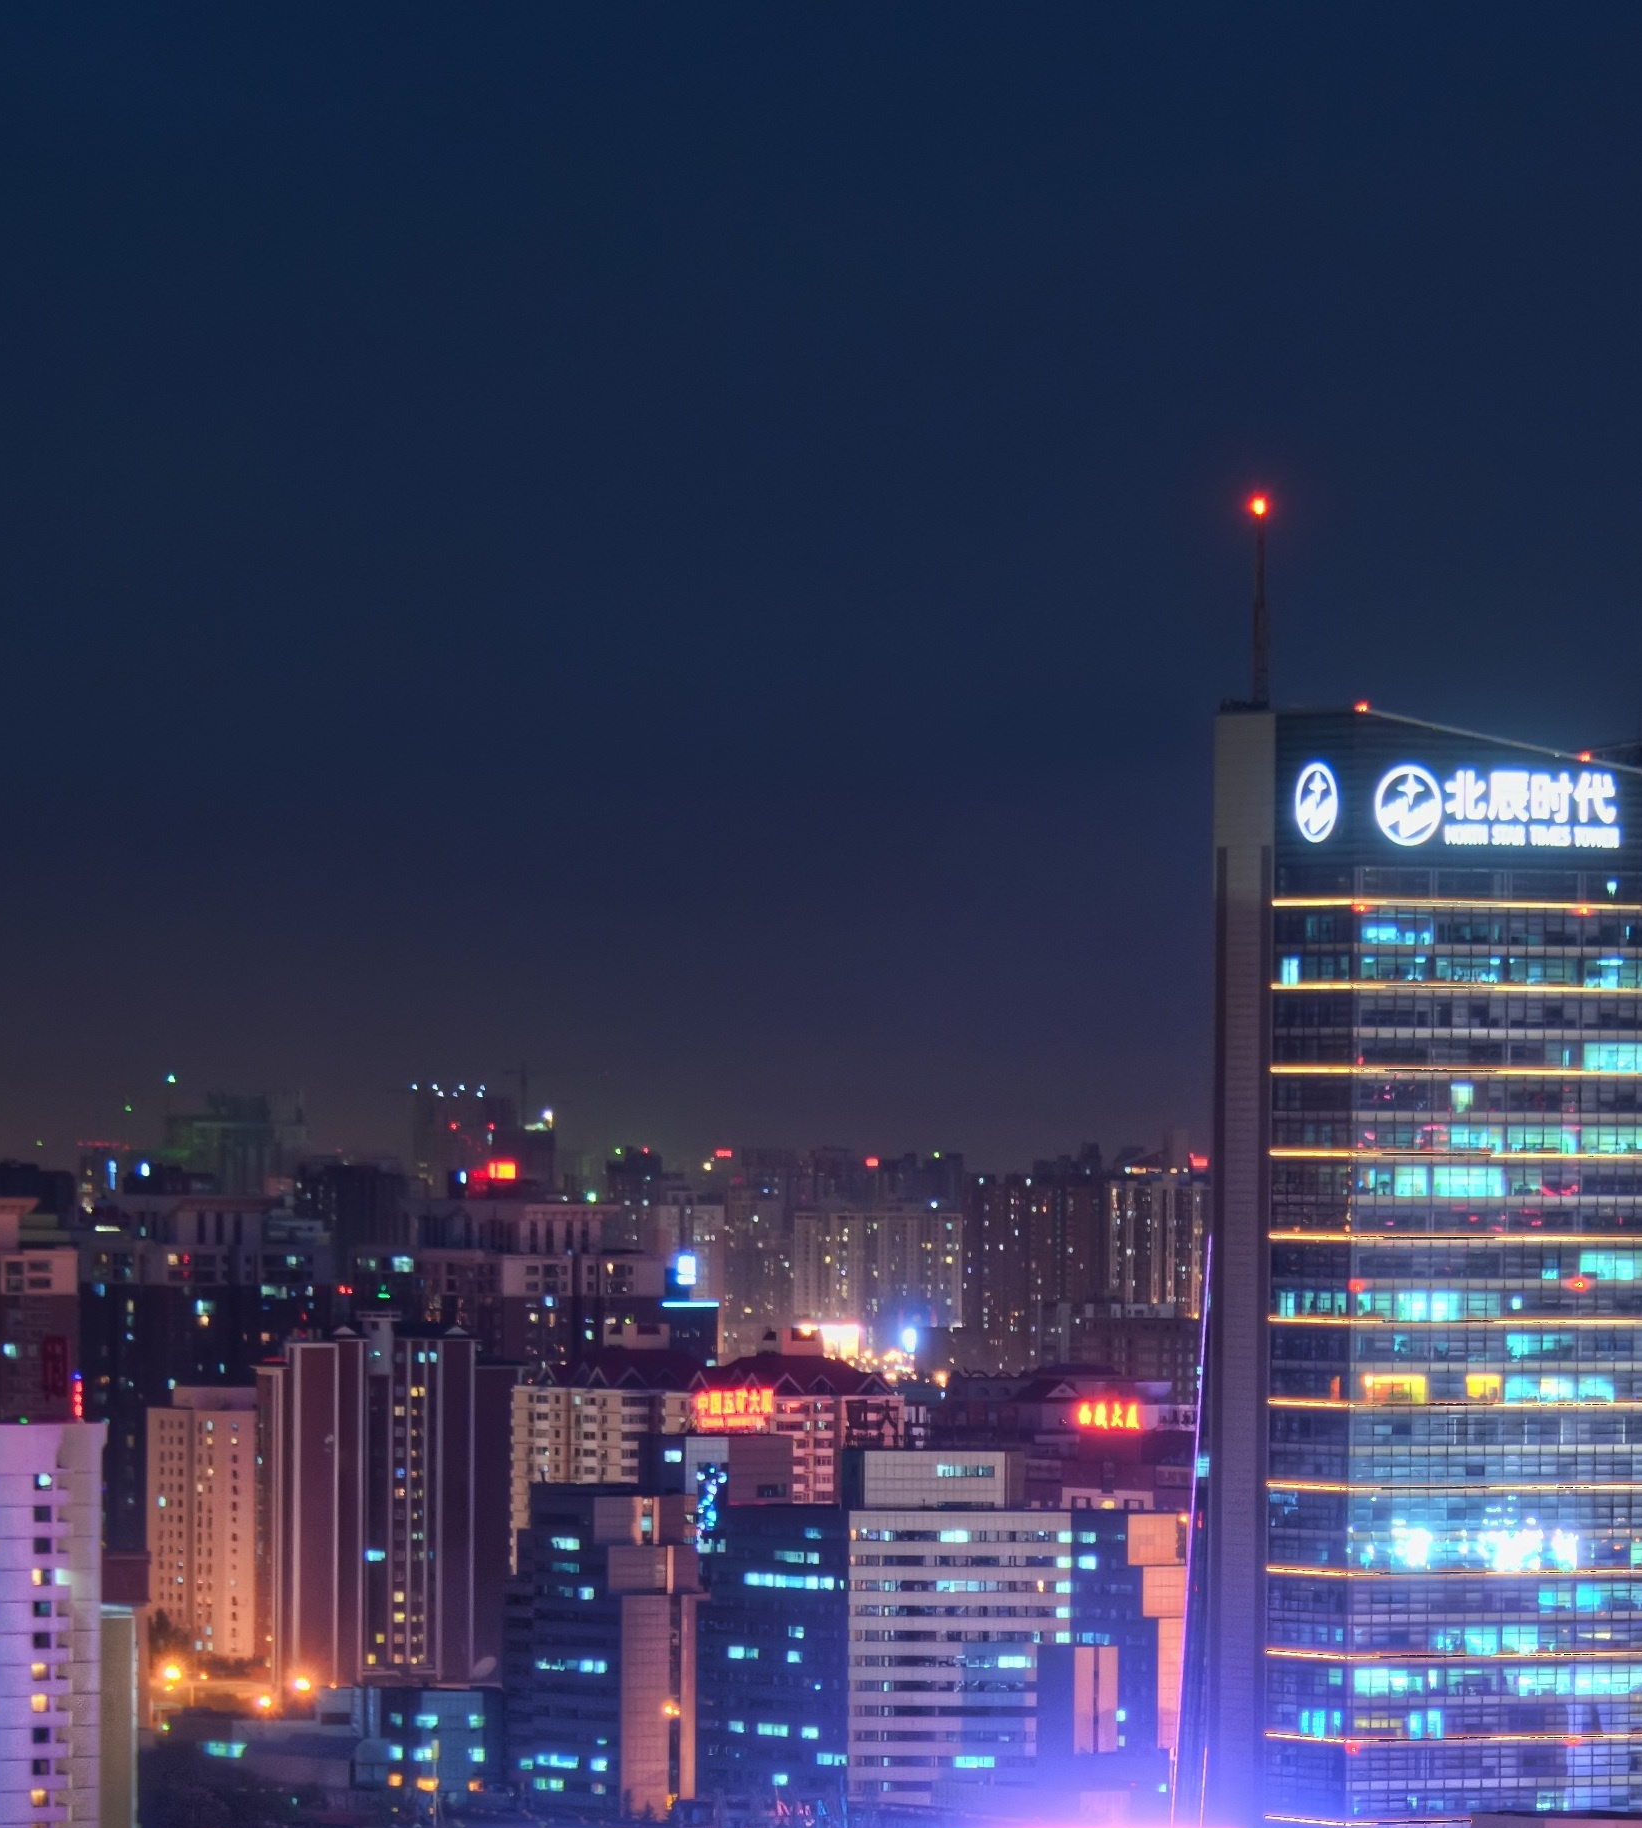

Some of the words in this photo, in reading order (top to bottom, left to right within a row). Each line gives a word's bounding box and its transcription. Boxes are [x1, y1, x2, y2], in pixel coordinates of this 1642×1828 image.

[1444, 770, 1617, 824] 北辰时代
[697, 1389, 774, 1415] 中国五矿大厦
